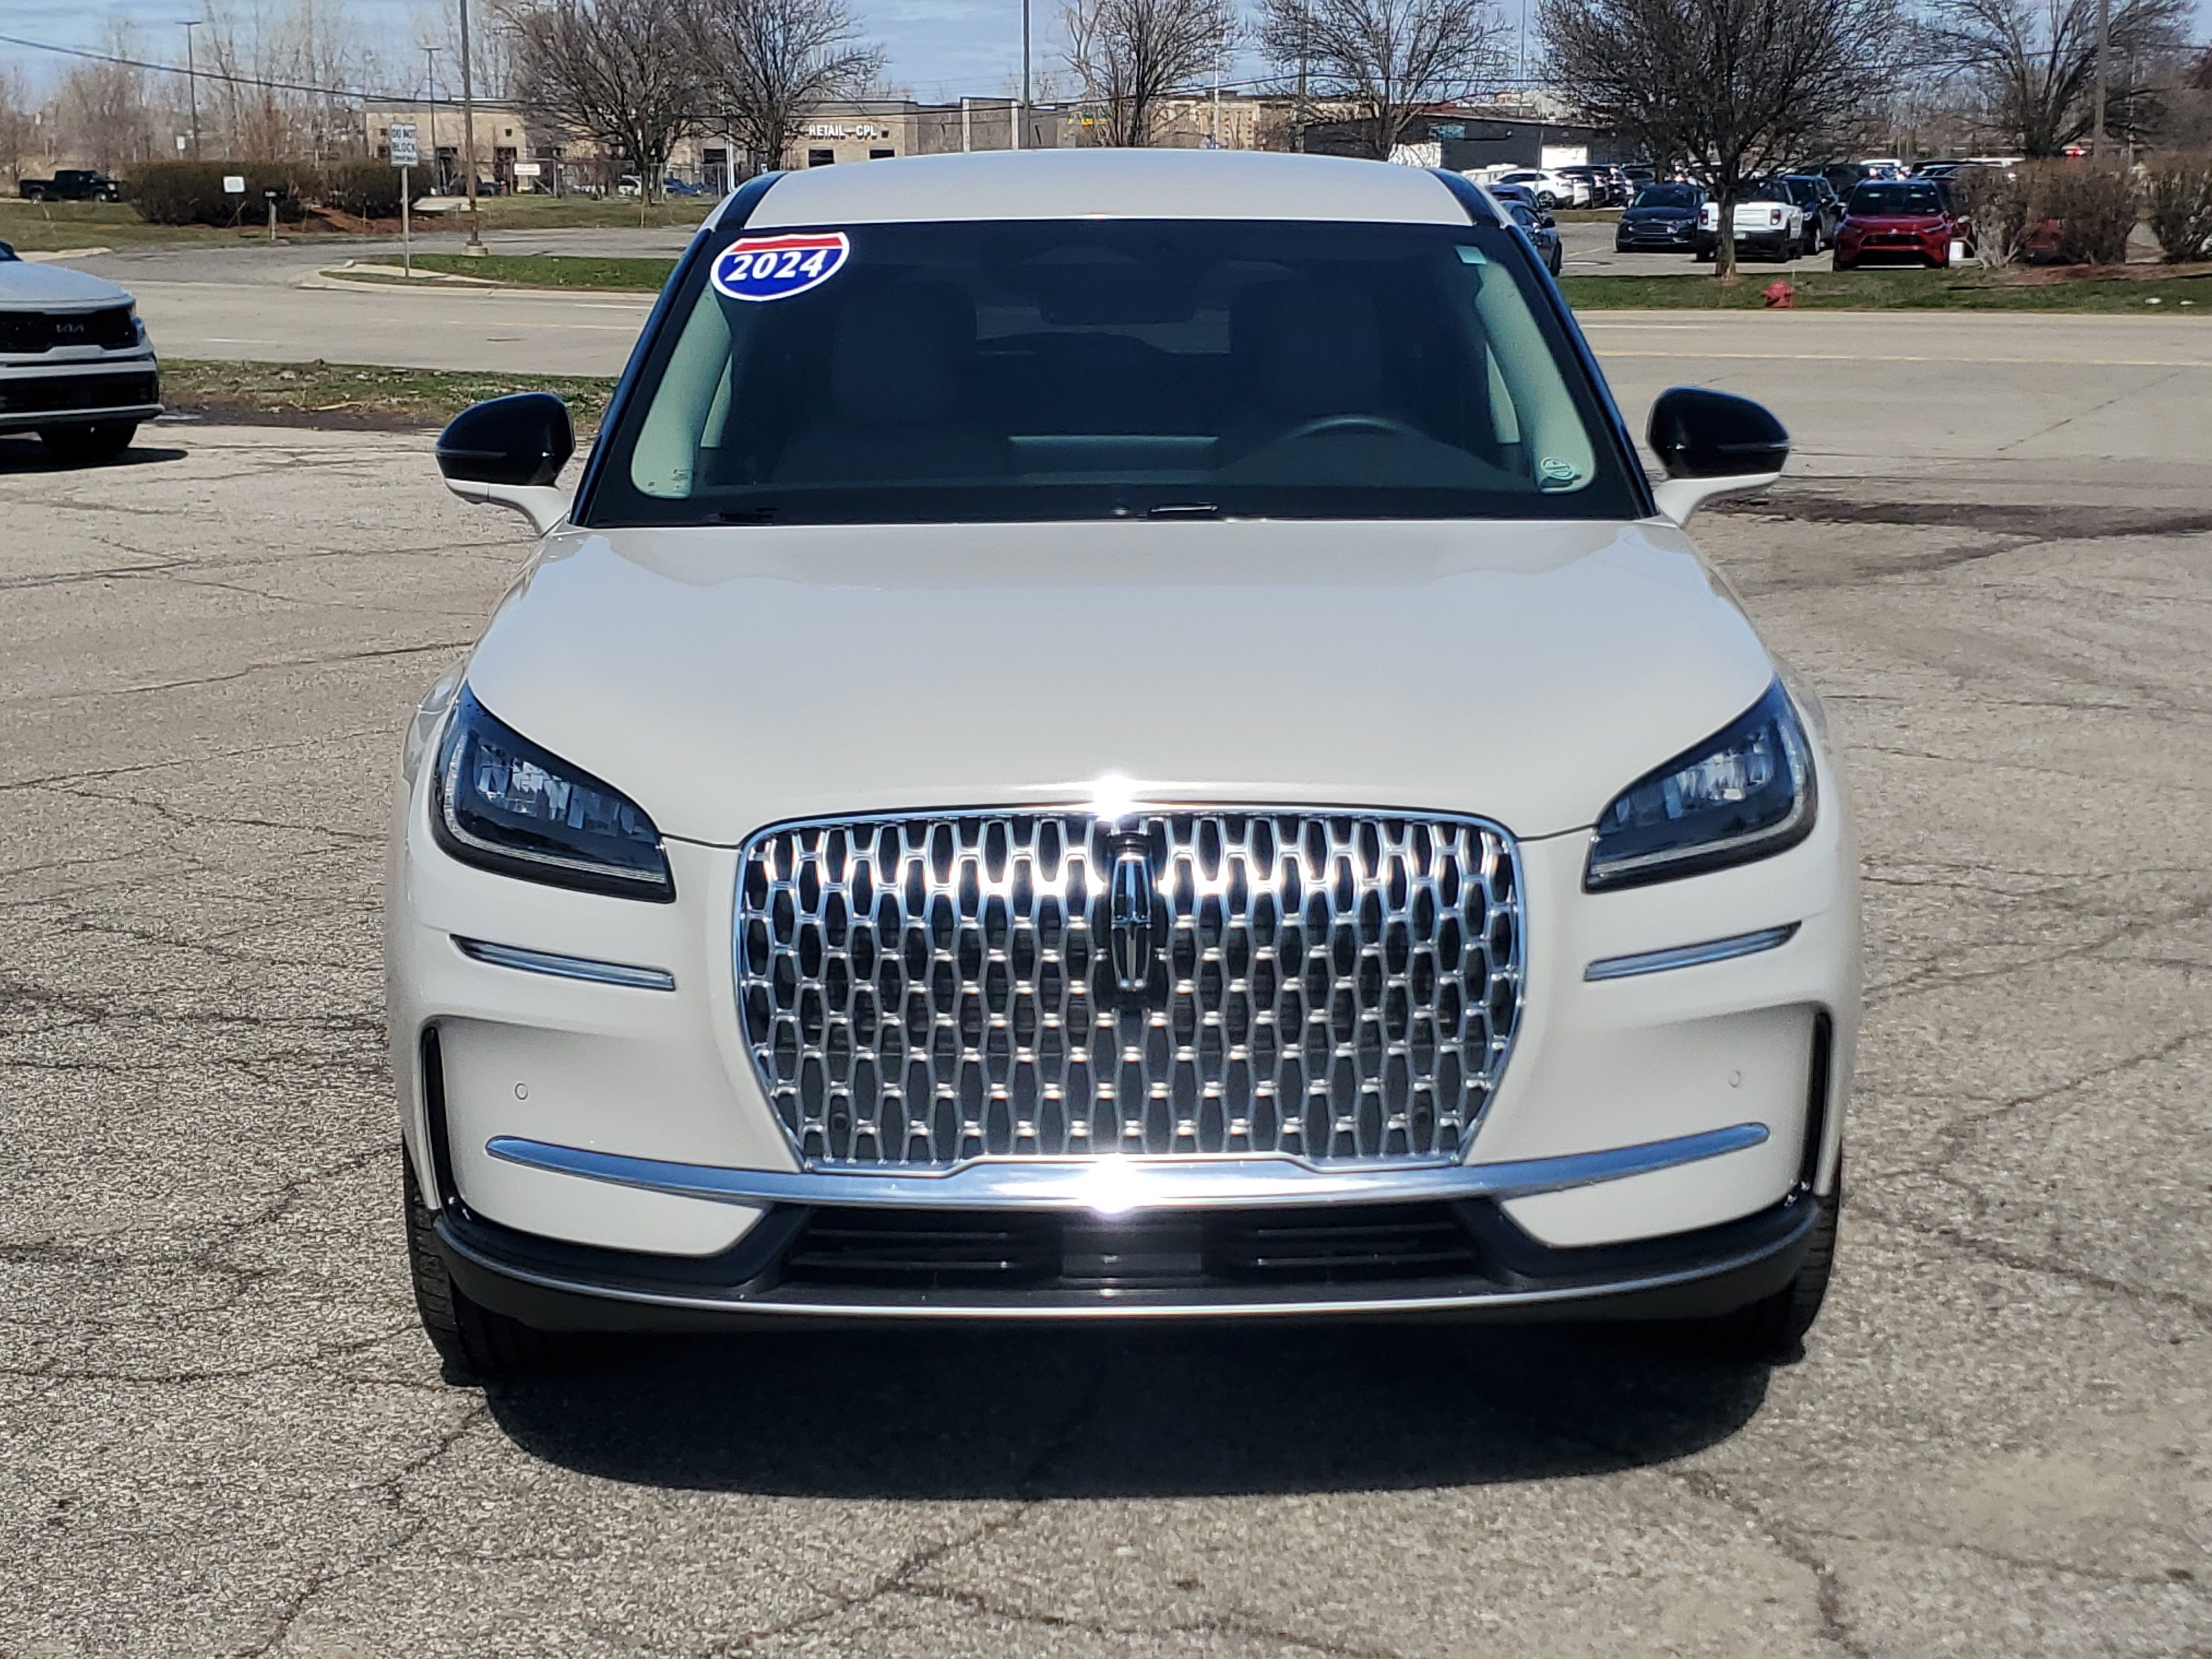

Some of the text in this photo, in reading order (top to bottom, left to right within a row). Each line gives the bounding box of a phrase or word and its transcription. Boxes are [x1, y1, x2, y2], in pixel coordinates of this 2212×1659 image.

[809, 125, 845, 136] RETAIL
[856, 125, 877, 136] CPL
[392, 142, 415, 153] BLOCK
[724, 250, 828, 281] 2024
